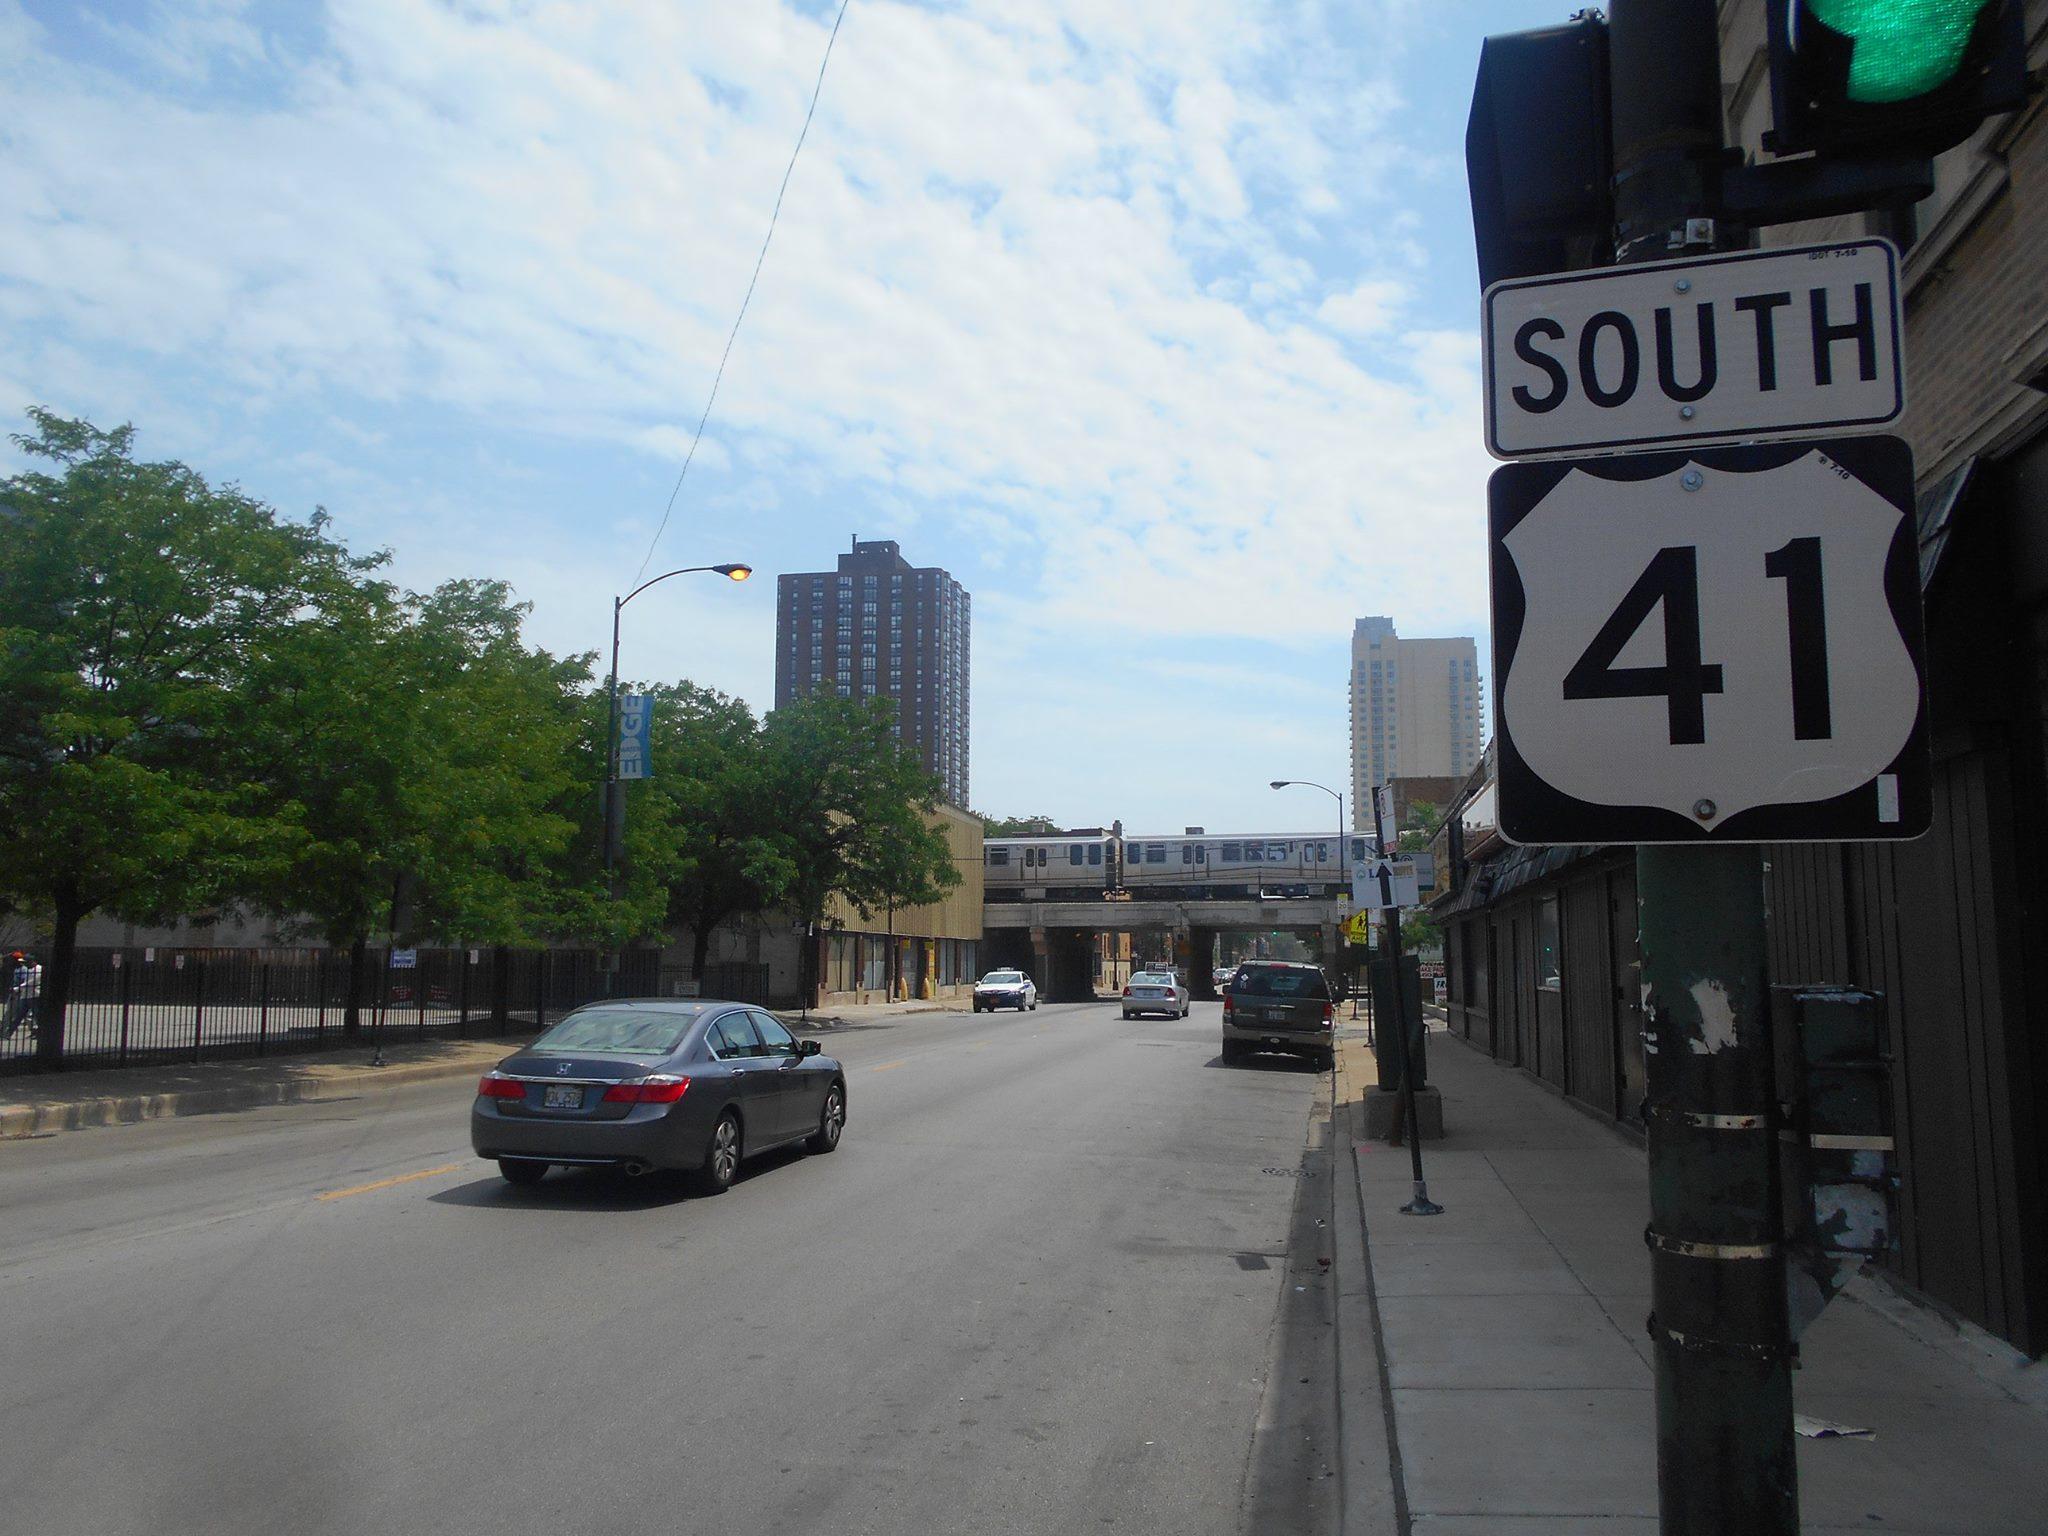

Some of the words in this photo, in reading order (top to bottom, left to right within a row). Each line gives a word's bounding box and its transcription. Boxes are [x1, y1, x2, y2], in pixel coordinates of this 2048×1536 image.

[1512, 282, 1877, 414] SOUTH
[1563, 536, 1832, 745] 41
[619, 696, 645, 779] EDGE
